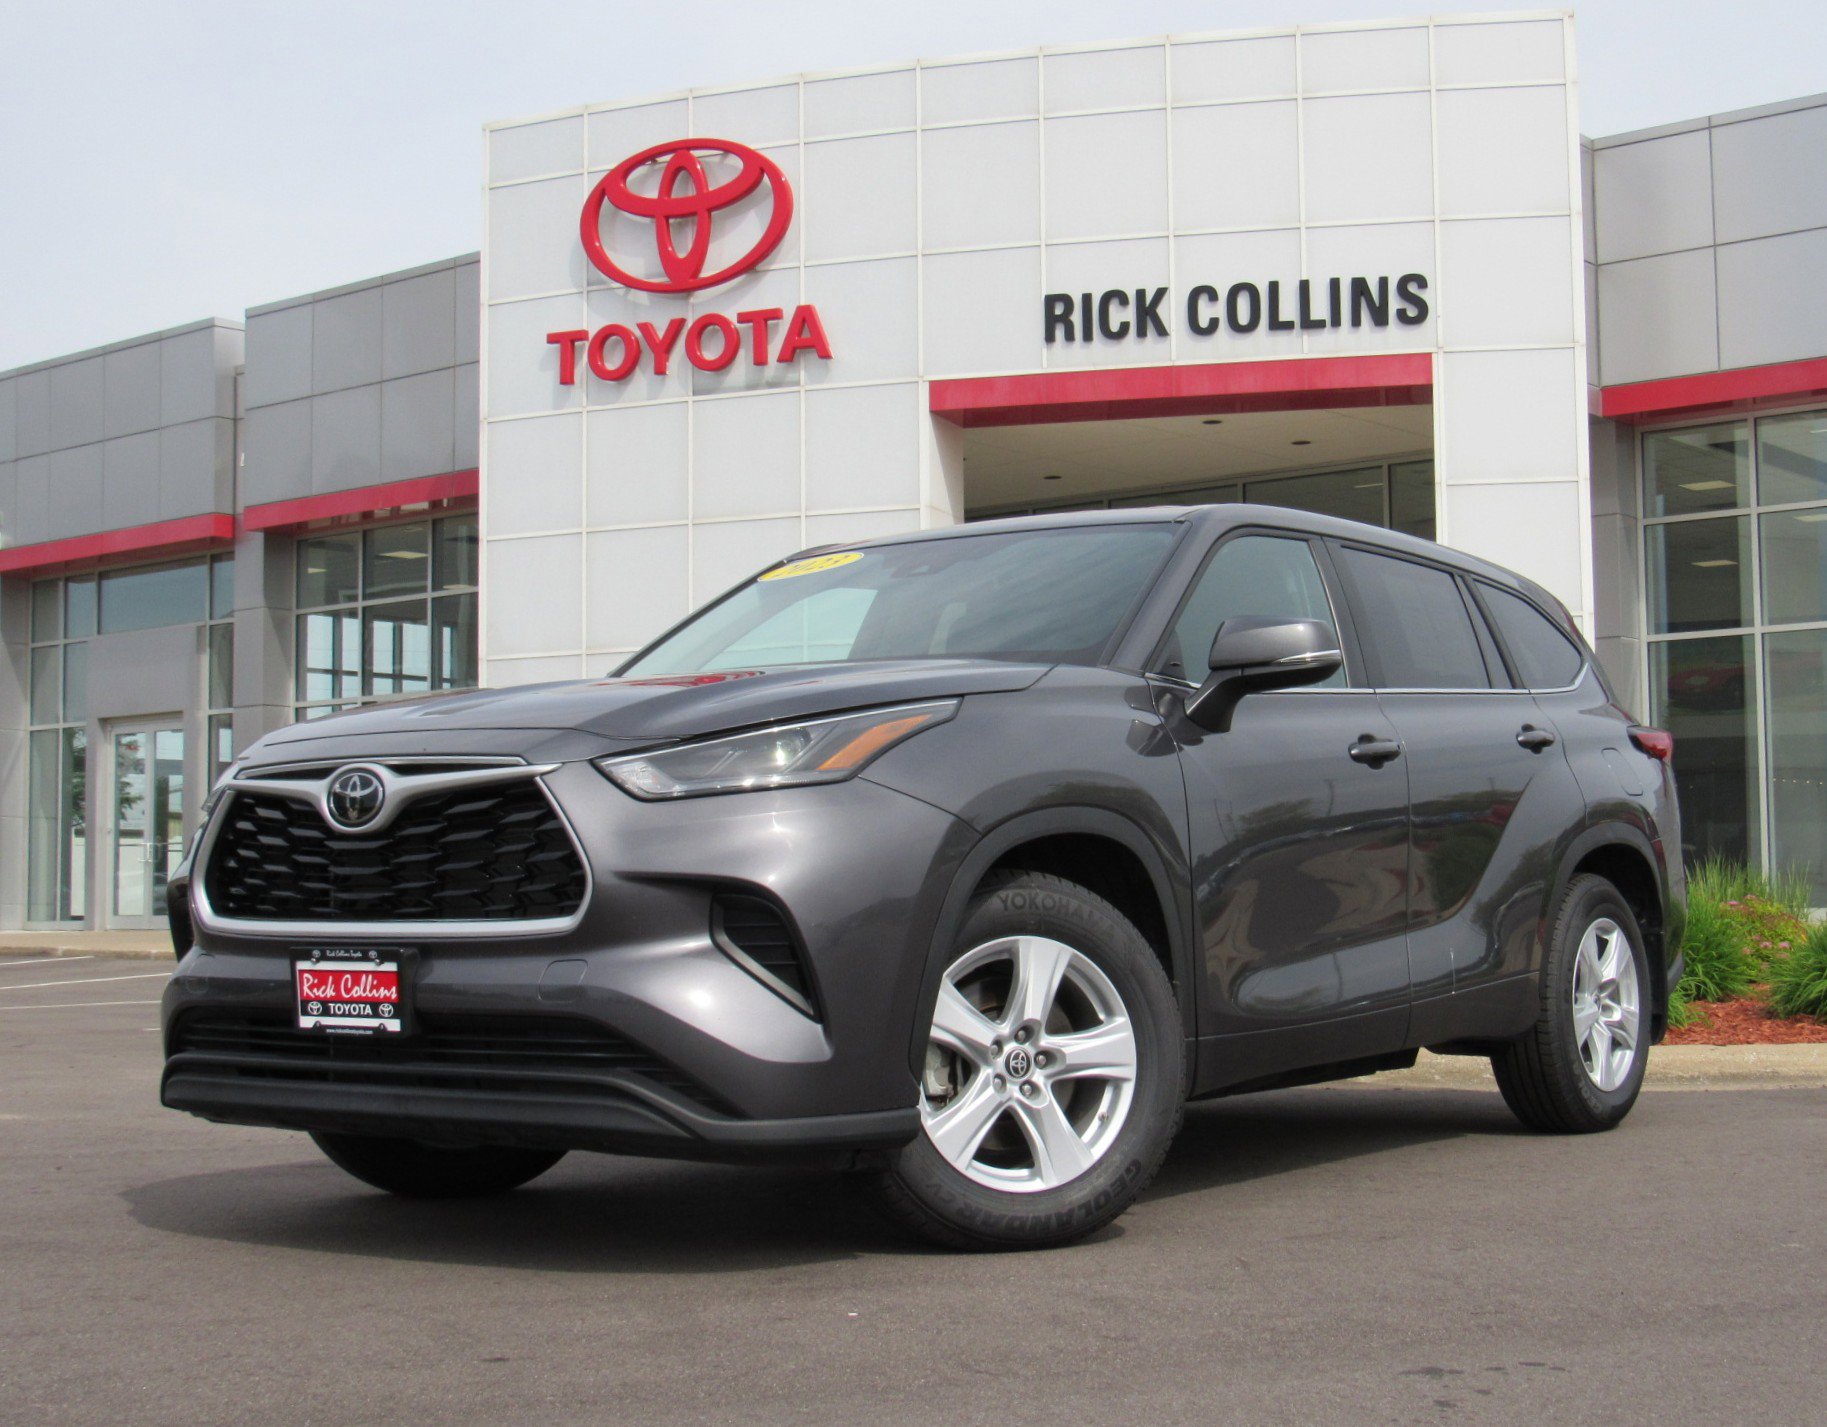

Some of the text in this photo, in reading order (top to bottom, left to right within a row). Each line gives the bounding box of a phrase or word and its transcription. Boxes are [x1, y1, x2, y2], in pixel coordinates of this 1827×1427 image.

[1044, 273, 1429, 343] RICK COLLINS
[546, 304, 834, 385] TOYOTA
[303, 973, 398, 999] Rick Collins
[328, 1003, 373, 1015] TOYOTA
